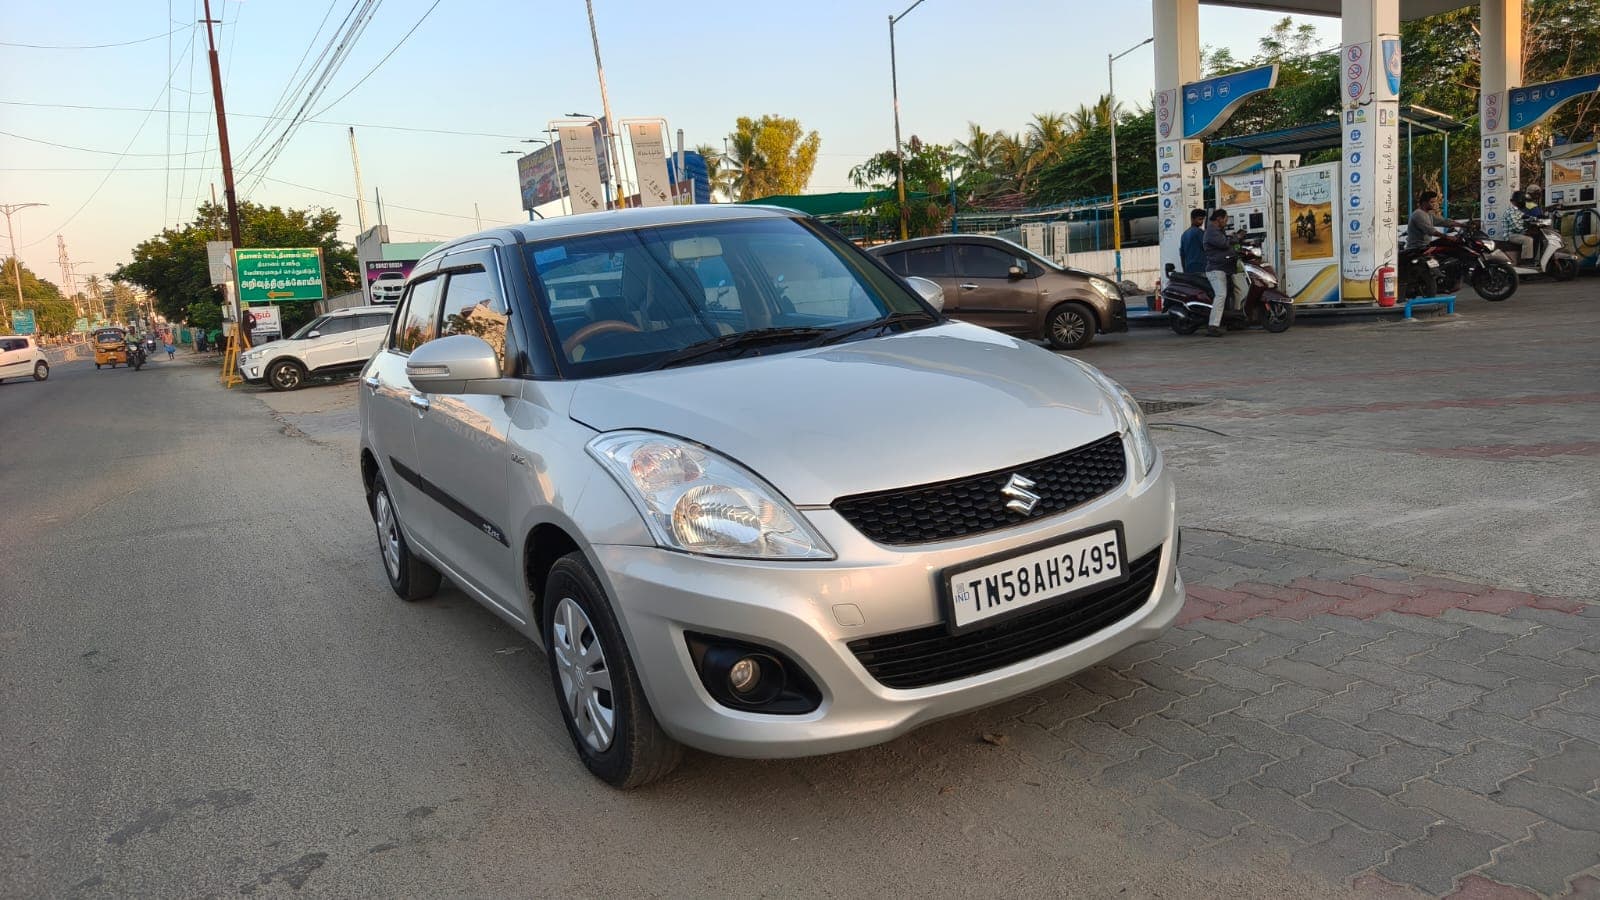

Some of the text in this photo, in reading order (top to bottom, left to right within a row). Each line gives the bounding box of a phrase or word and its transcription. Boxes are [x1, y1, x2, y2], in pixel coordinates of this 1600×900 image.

[1190, 114, 1195, 124] 1
[1516, 112, 1523, 121] 3
[969, 541, 1117, 611] TN58AH3495
